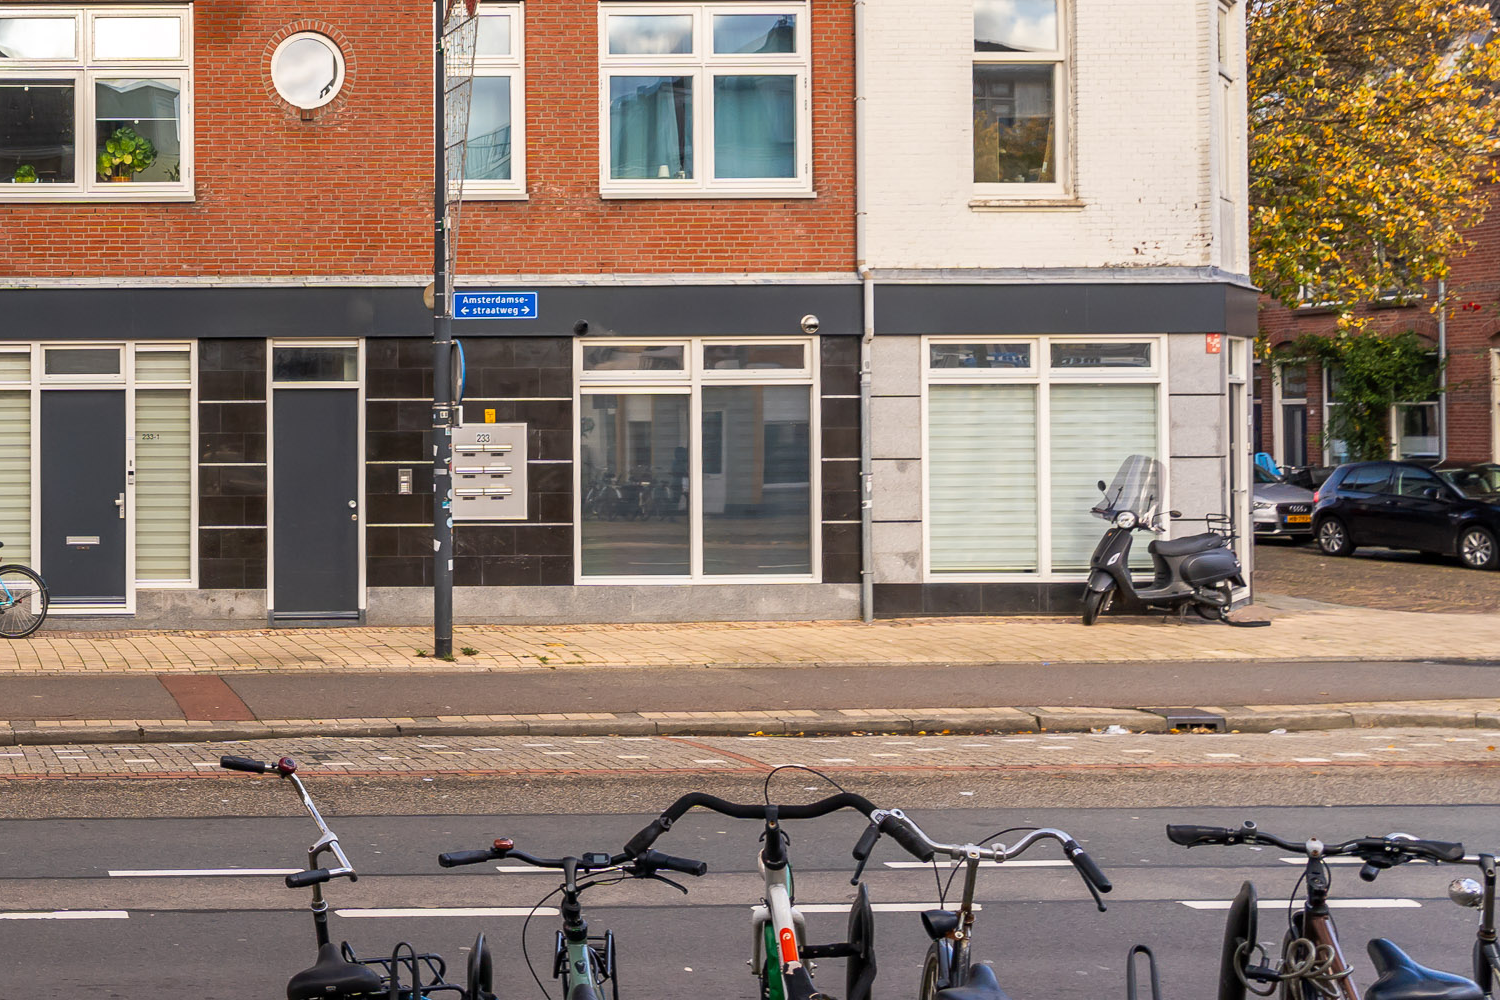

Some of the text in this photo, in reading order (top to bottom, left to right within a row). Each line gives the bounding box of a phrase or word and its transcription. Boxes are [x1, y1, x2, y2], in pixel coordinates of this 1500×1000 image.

[462, 296, 529, 304] Amsterdamse-
[472, 307, 519, 316] straatweg
[476, 433, 490, 443] 233
